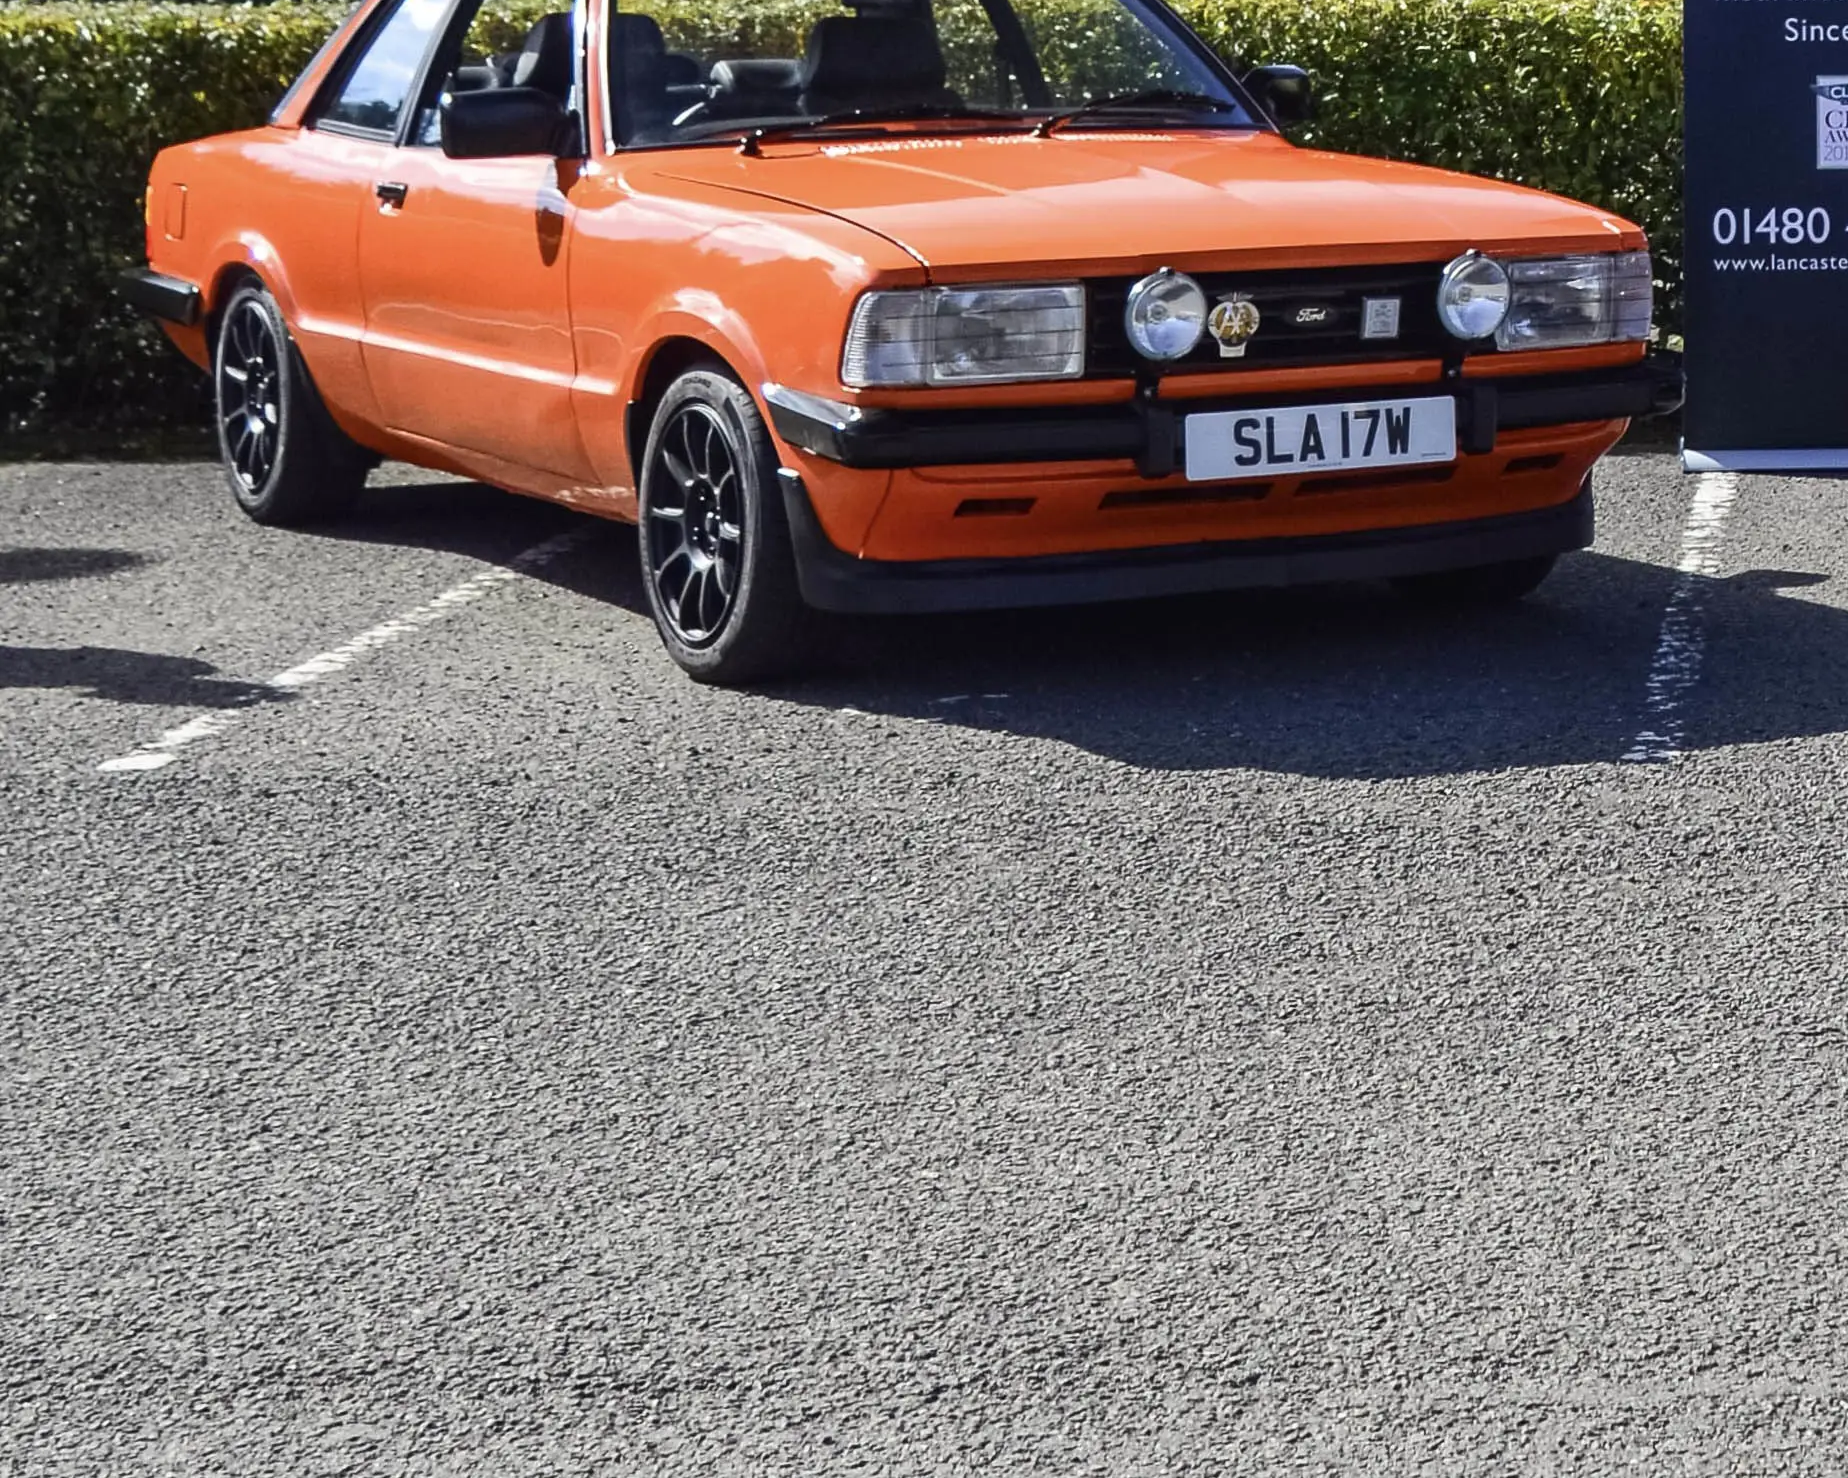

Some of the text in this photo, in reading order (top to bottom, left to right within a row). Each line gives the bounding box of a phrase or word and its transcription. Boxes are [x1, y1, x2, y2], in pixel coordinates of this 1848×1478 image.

[1713, 207, 1830, 245] 01480
[1296, 307, 1326, 323] Ford
[1233, 406, 1411, 467] SLA 17W
